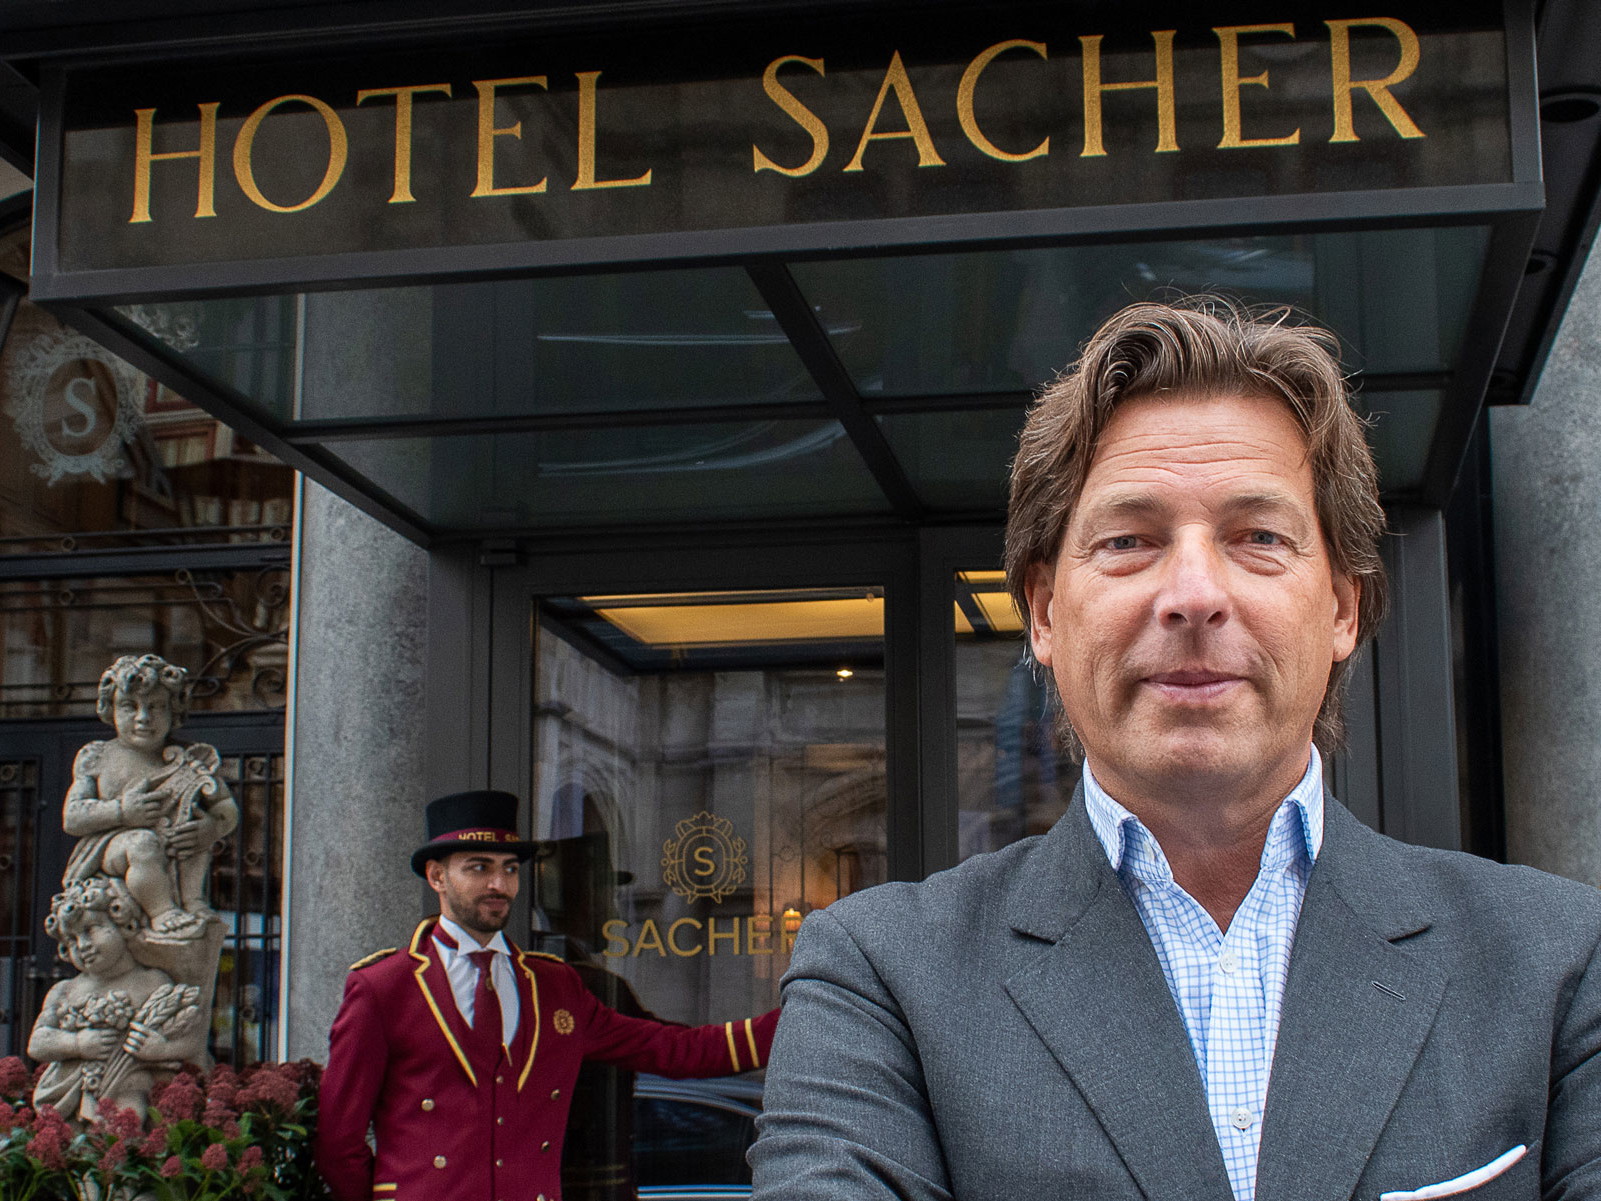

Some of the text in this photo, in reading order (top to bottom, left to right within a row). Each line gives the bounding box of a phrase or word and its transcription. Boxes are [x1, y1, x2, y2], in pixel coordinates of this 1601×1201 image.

[128, 16, 1426, 224] HOTEL SACHER
[62, 377, 98, 438] S
[693, 846, 716, 877] S
